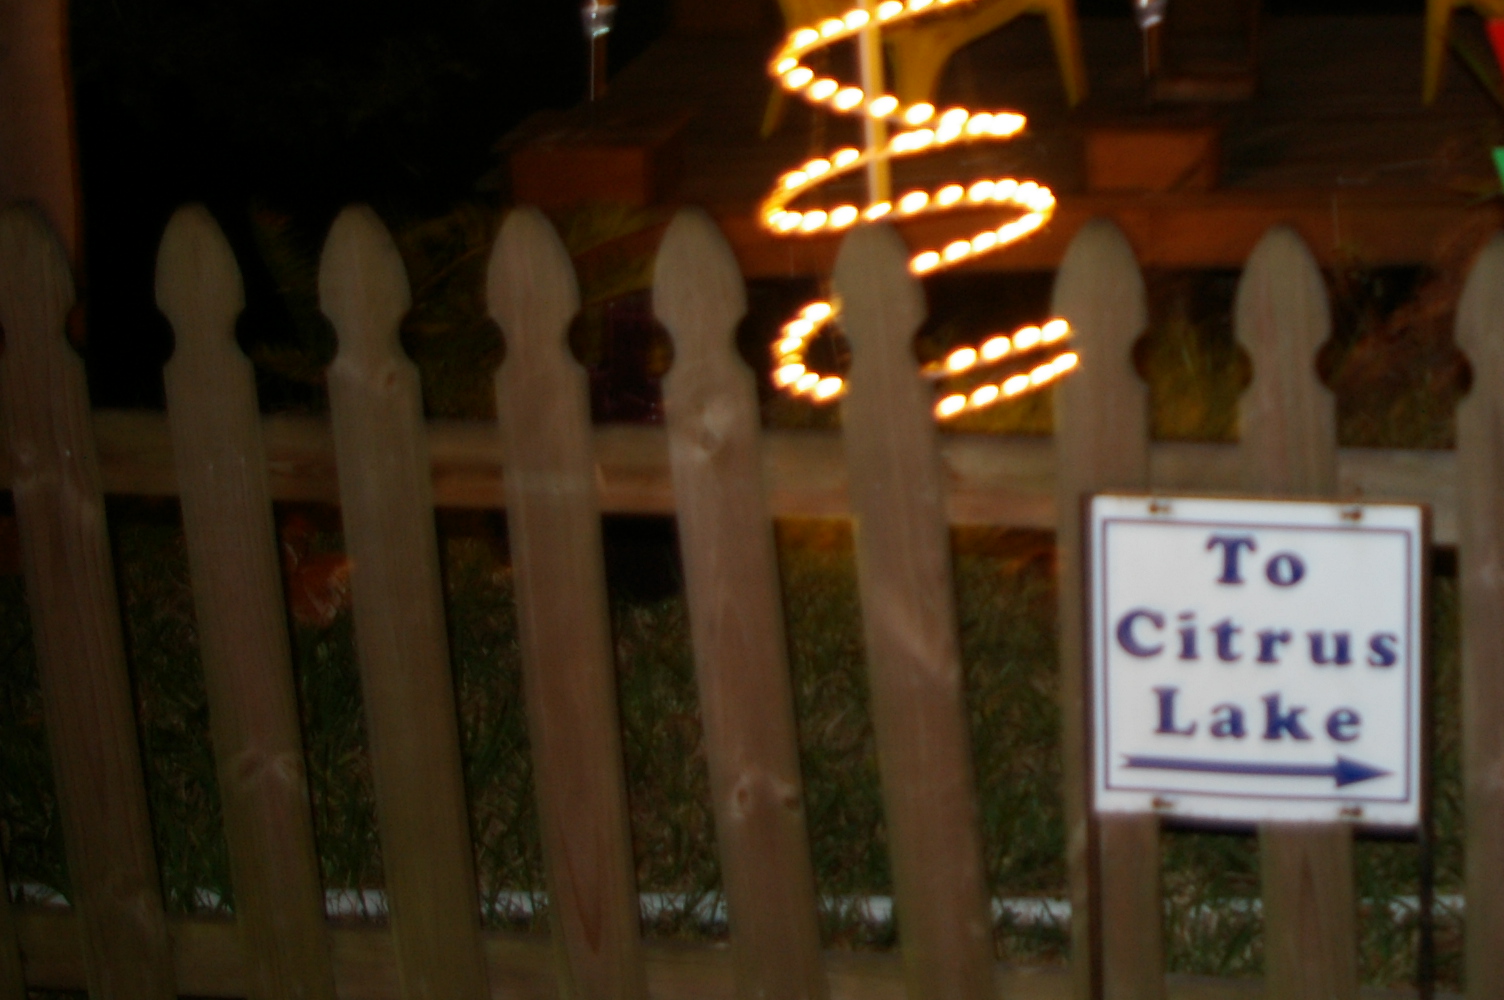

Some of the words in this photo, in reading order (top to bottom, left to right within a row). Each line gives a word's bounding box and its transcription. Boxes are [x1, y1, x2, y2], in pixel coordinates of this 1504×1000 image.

[1206, 534, 1307, 587] To
[1115, 607, 1399, 668] Citrus
[1152, 685, 1363, 743] Lake
